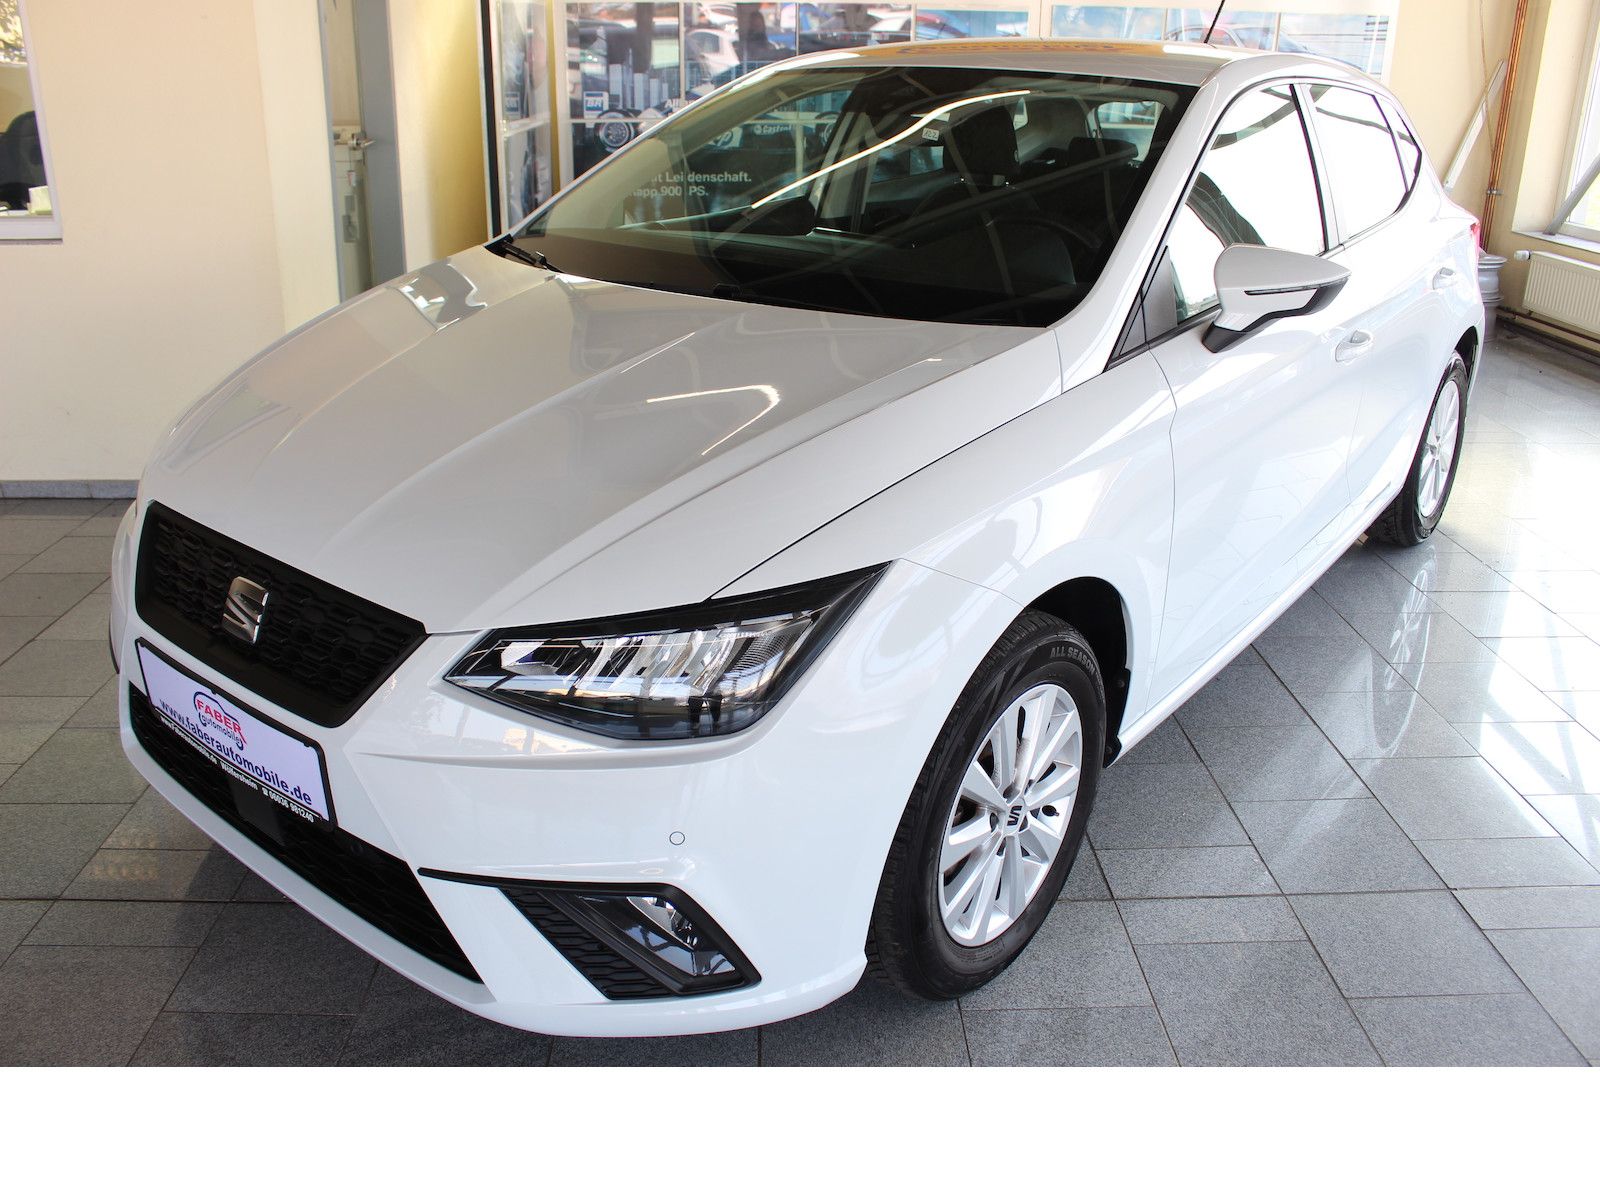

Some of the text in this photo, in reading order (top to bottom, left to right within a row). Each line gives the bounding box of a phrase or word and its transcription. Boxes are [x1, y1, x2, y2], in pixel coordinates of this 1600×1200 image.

[665, 171, 752, 182] Leidenschaft.
[688, 186, 709, 196] PS.
[1050, 646, 1097, 674] ALL SEASON
[197, 700, 245, 740] FABER
[159, 699, 312, 805] www.faberautomobile.de
